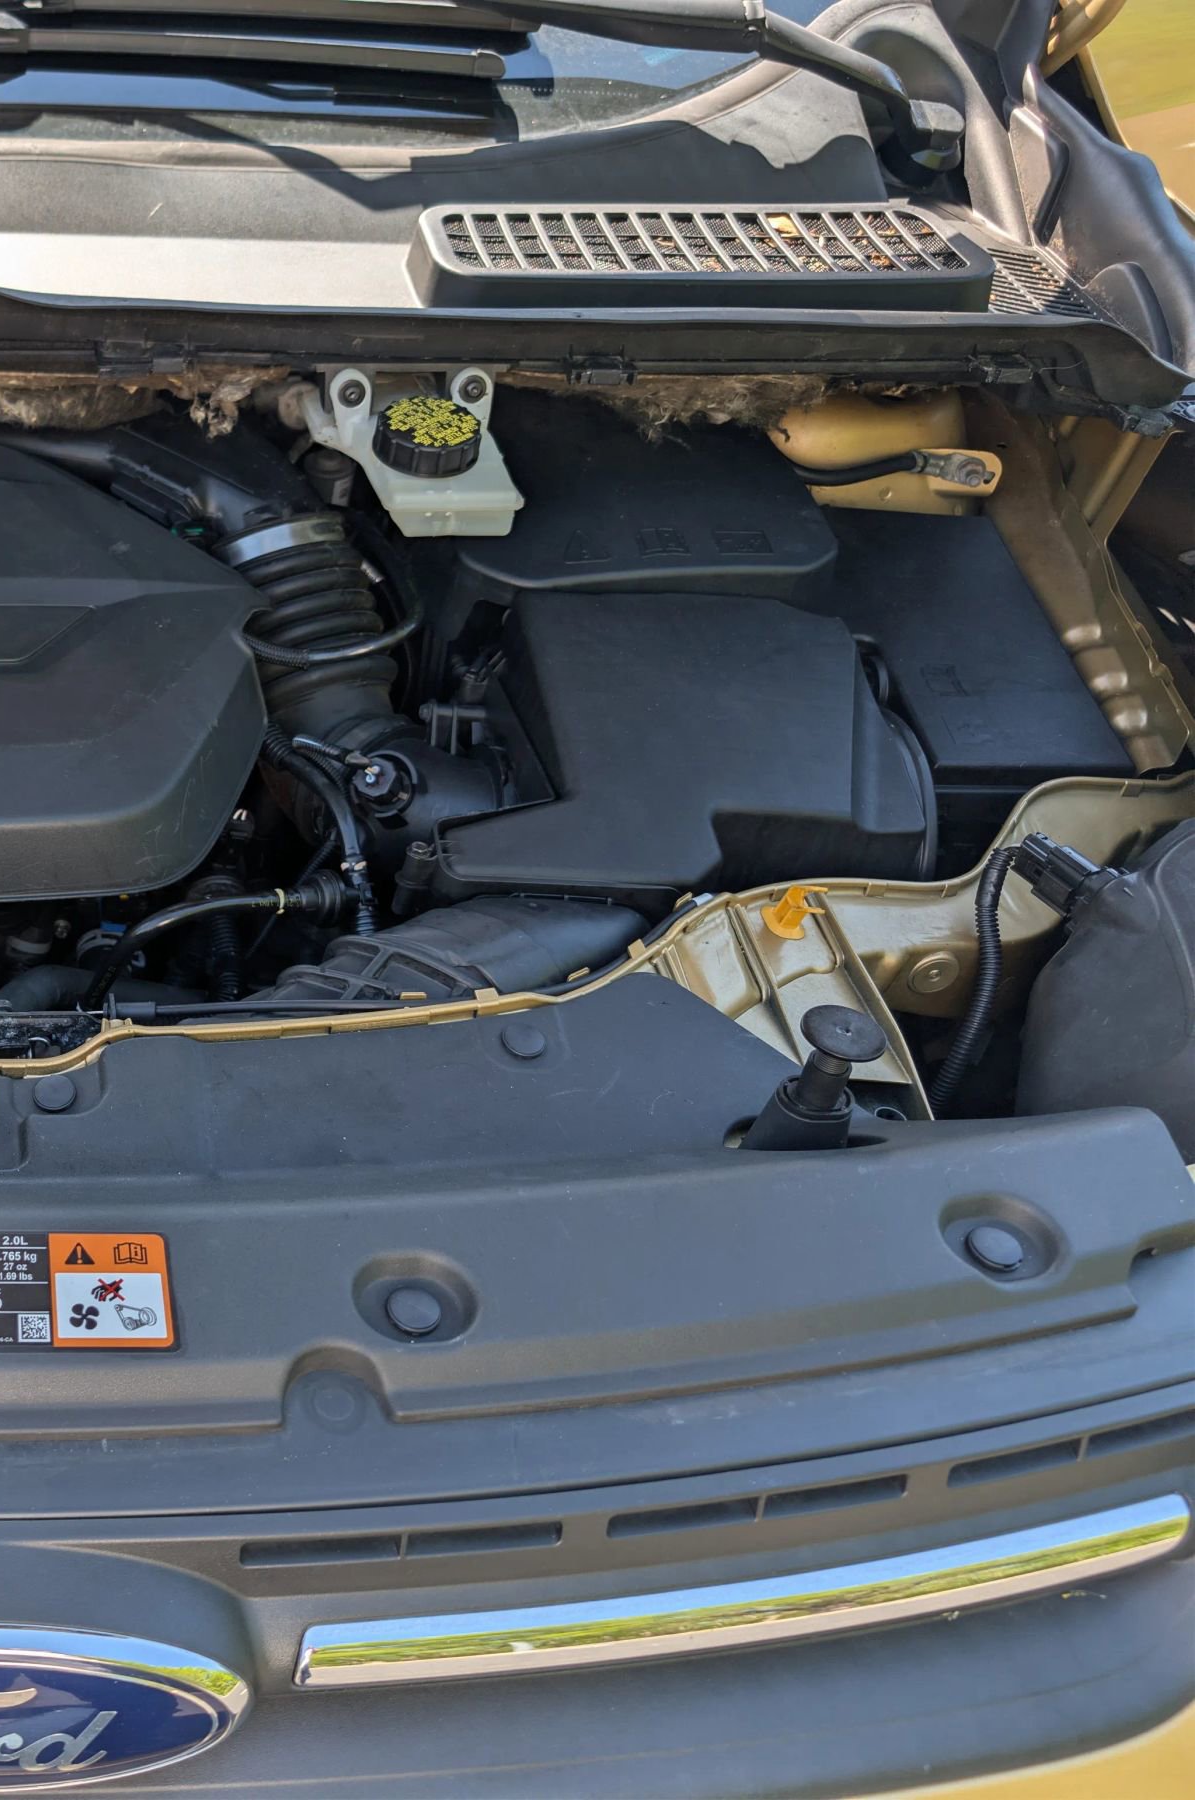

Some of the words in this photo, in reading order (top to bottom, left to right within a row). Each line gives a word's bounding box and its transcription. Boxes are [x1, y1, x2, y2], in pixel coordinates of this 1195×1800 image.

[2, 1235, 29, 1246] 2.0L
[24, 1251, 37, 1263] kg
[3, 1262, 14, 1271] 27
[19, 1272, 33, 1280] lbs
